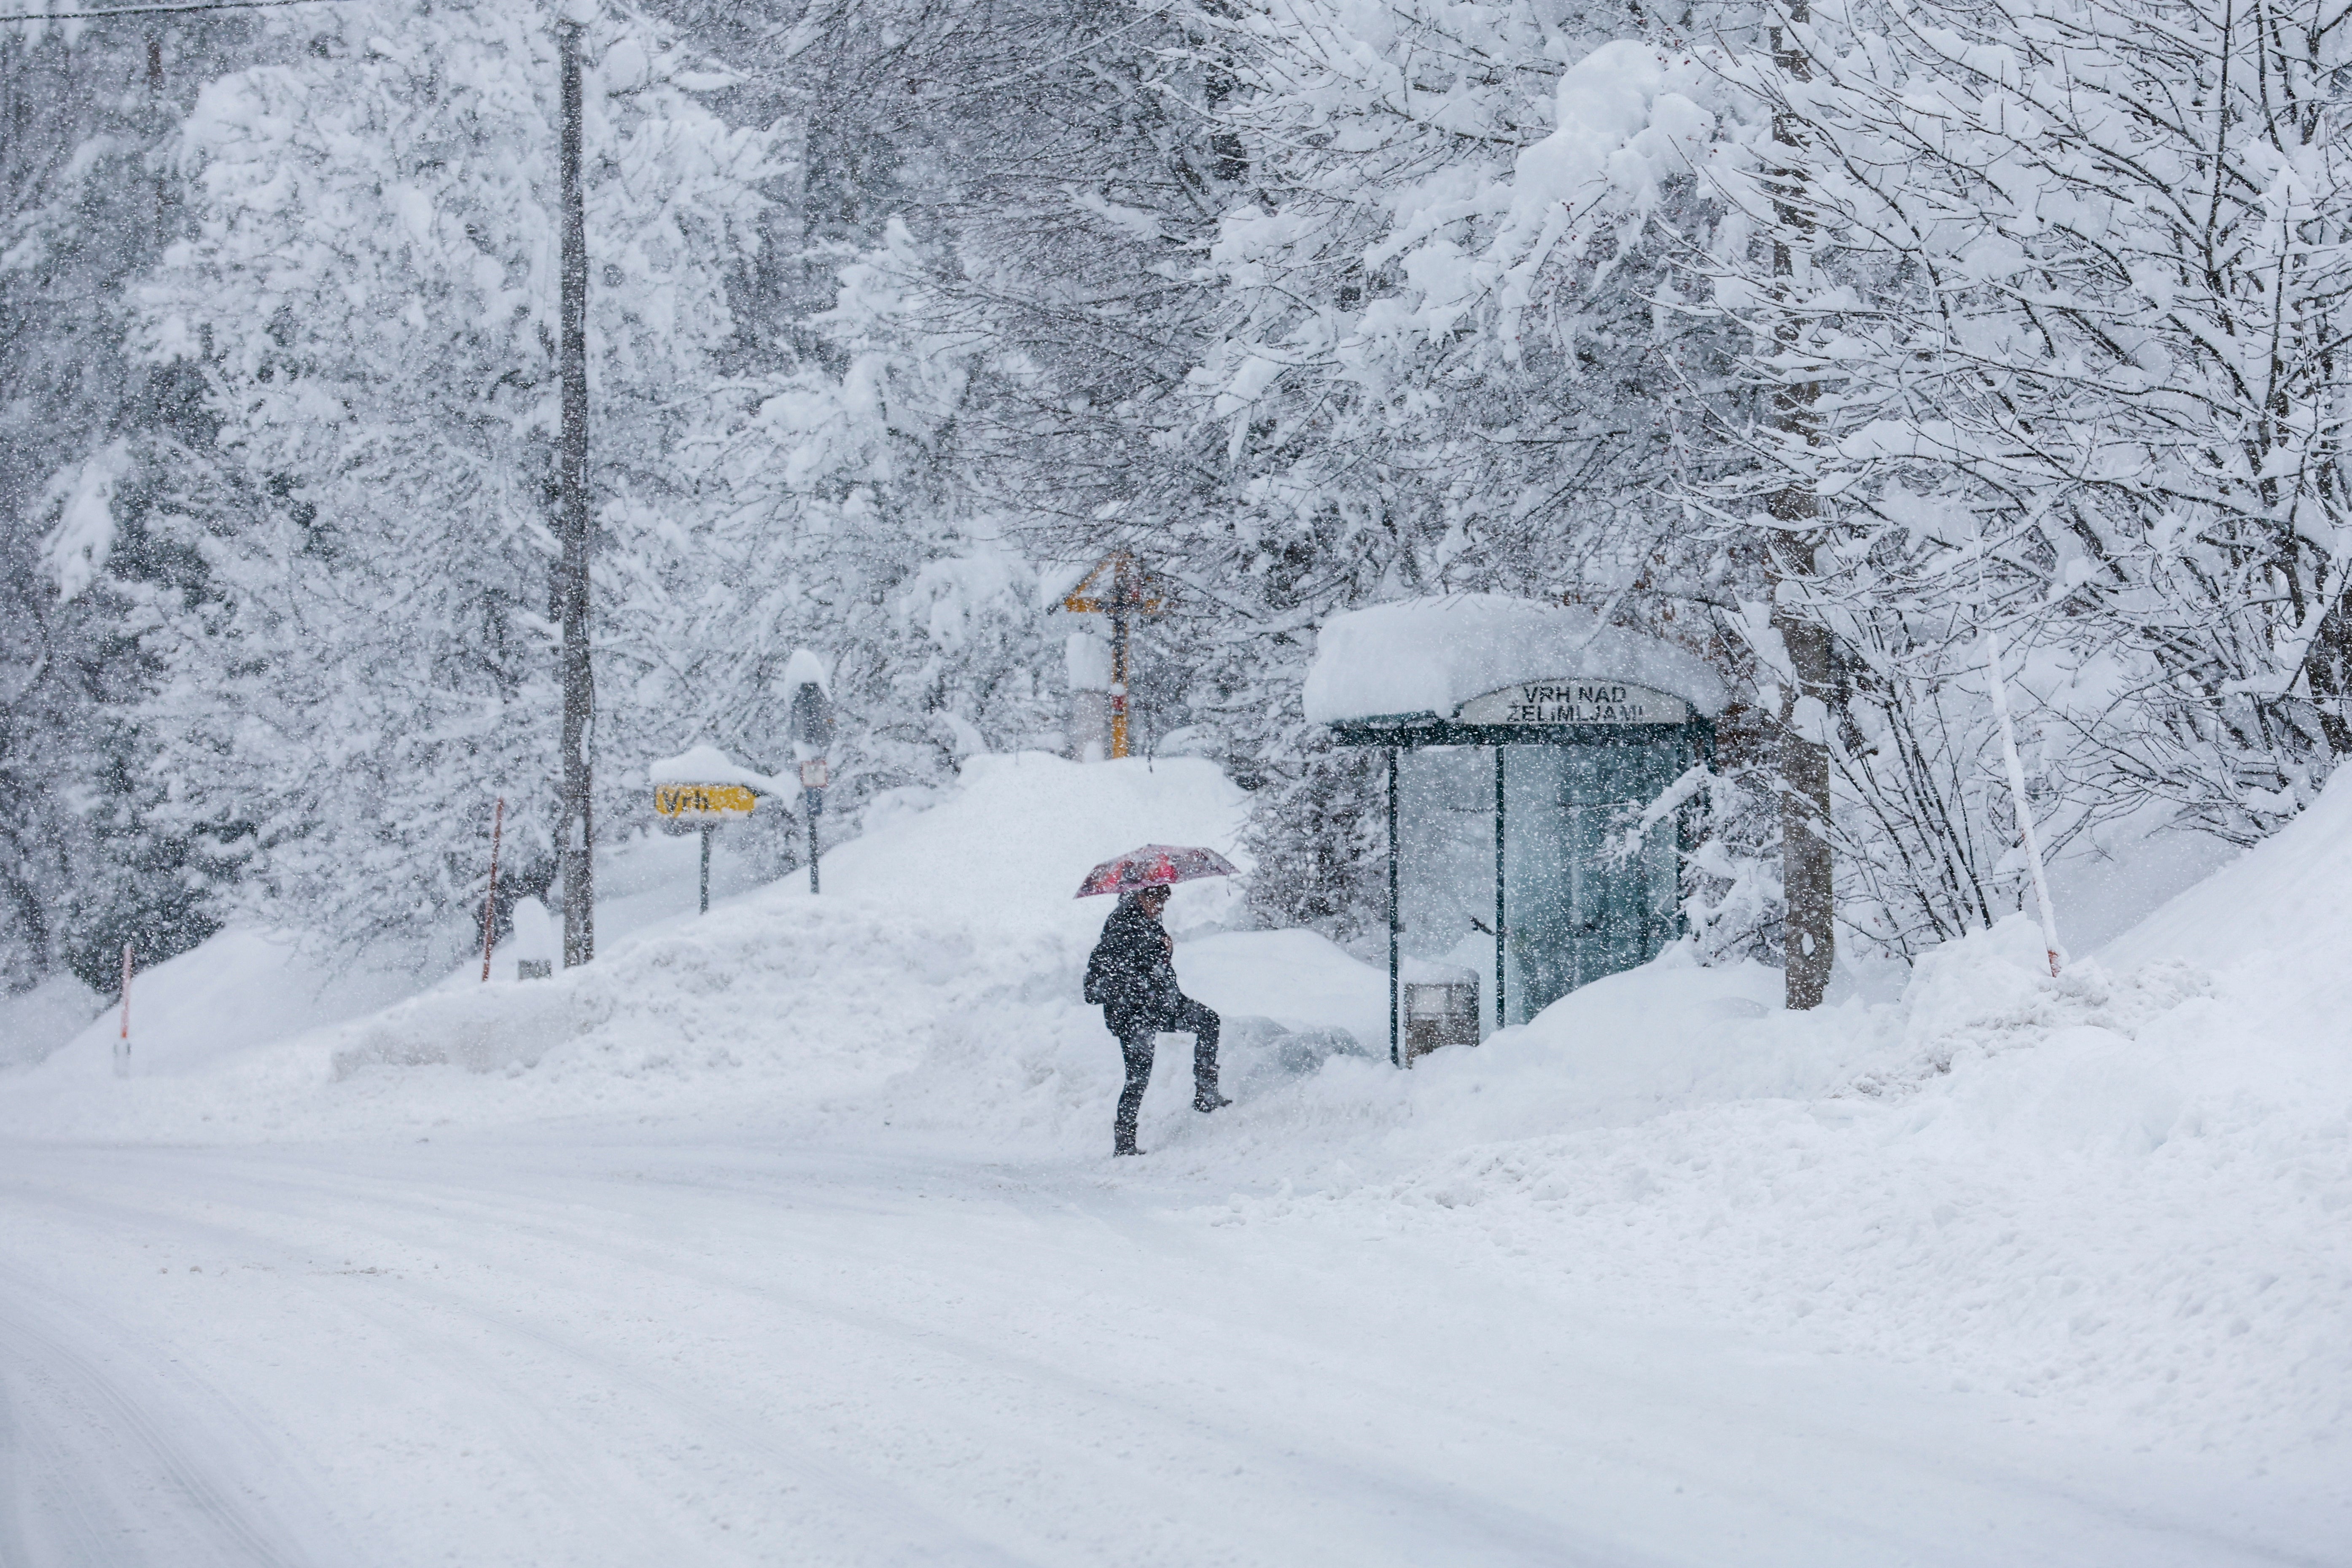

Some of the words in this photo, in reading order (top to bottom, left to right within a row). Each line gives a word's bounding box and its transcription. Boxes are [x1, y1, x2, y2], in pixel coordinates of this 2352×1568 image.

[1524, 686, 1570, 703] VRH
[1578, 686, 1626, 703] NAD
[663, 790, 709, 812] Vrh
